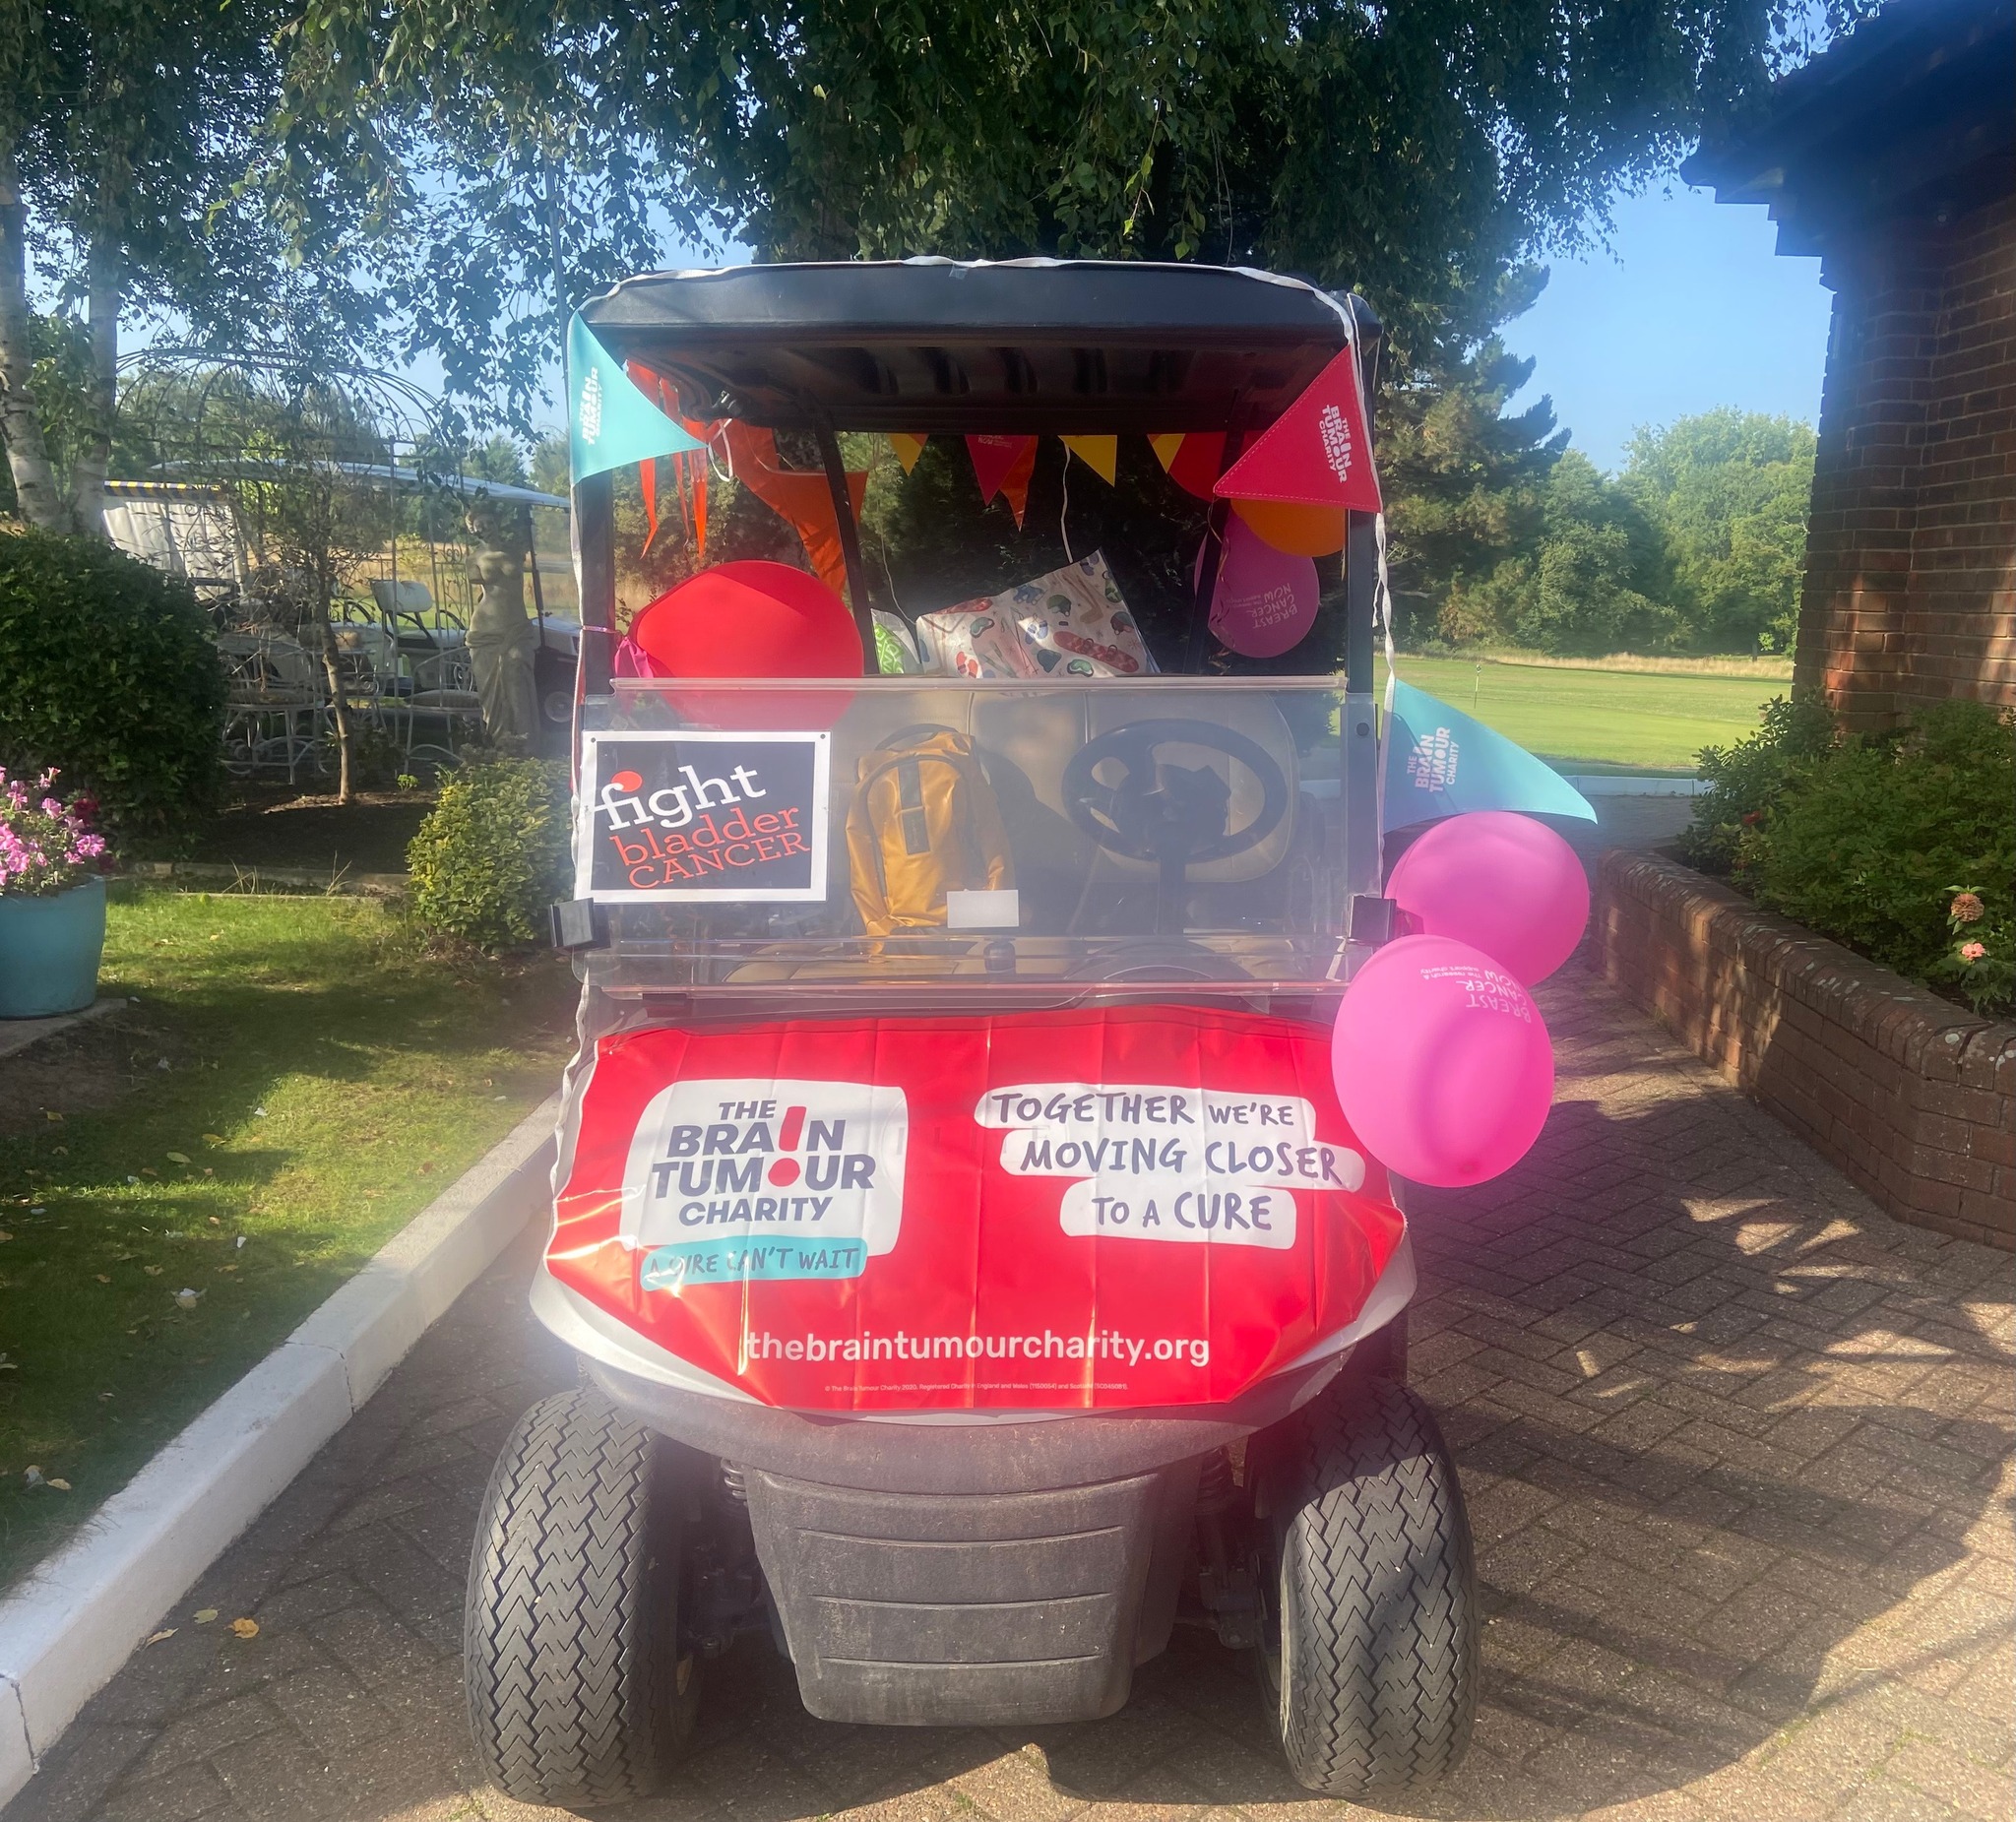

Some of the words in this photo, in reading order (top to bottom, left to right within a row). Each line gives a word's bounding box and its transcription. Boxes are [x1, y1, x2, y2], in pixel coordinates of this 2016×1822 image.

[1319, 420, 1337, 471] CHARITY
[1322, 405, 1348, 484] TUMOUR
[1331, 406, 1353, 469] BRAIN
[1342, 417, 1352, 440] THE
[1246, 594, 1294, 618] CANCER
[1264, 583, 1292, 603] NOW
[1252, 603, 1297, 629] BREAST
[1407, 756, 1418, 775] THE
[1413, 734, 1434, 788] BRAIN
[1429, 726, 1450, 792] TUMOUR
[1446, 740, 1459, 785] CHARITY
[593, 764, 767, 831] fight
[608, 804, 800, 867] bladder
[628, 832, 811, 890] CANCER
[1456, 979, 1527, 1006] CANCER
[1466, 993, 1532, 1024] BREAST
[718, 1099, 777, 1121] THE
[991, 1091, 1196, 1126] TOGETHER
[1208, 1101, 1294, 1127] WE'RE
[666, 1105, 847, 1159] BRAIN
[652, 1154, 877, 1200] TUMOUR
[1020, 1137, 1188, 1175] MOVING
[1204, 1141, 1344, 1186] CLOSER
[678, 1196, 834, 1227] CHARITY
[1091, 1195, 1130, 1225] TO
[1142, 1199, 1162, 1227] A
[1173, 1191, 1273, 1231] CURE
[725, 1247, 793, 1272] CAN'T
[798, 1247, 859, 1271] WAIT
[745, 1329, 1211, 1368] thebraintumourcharity.org
